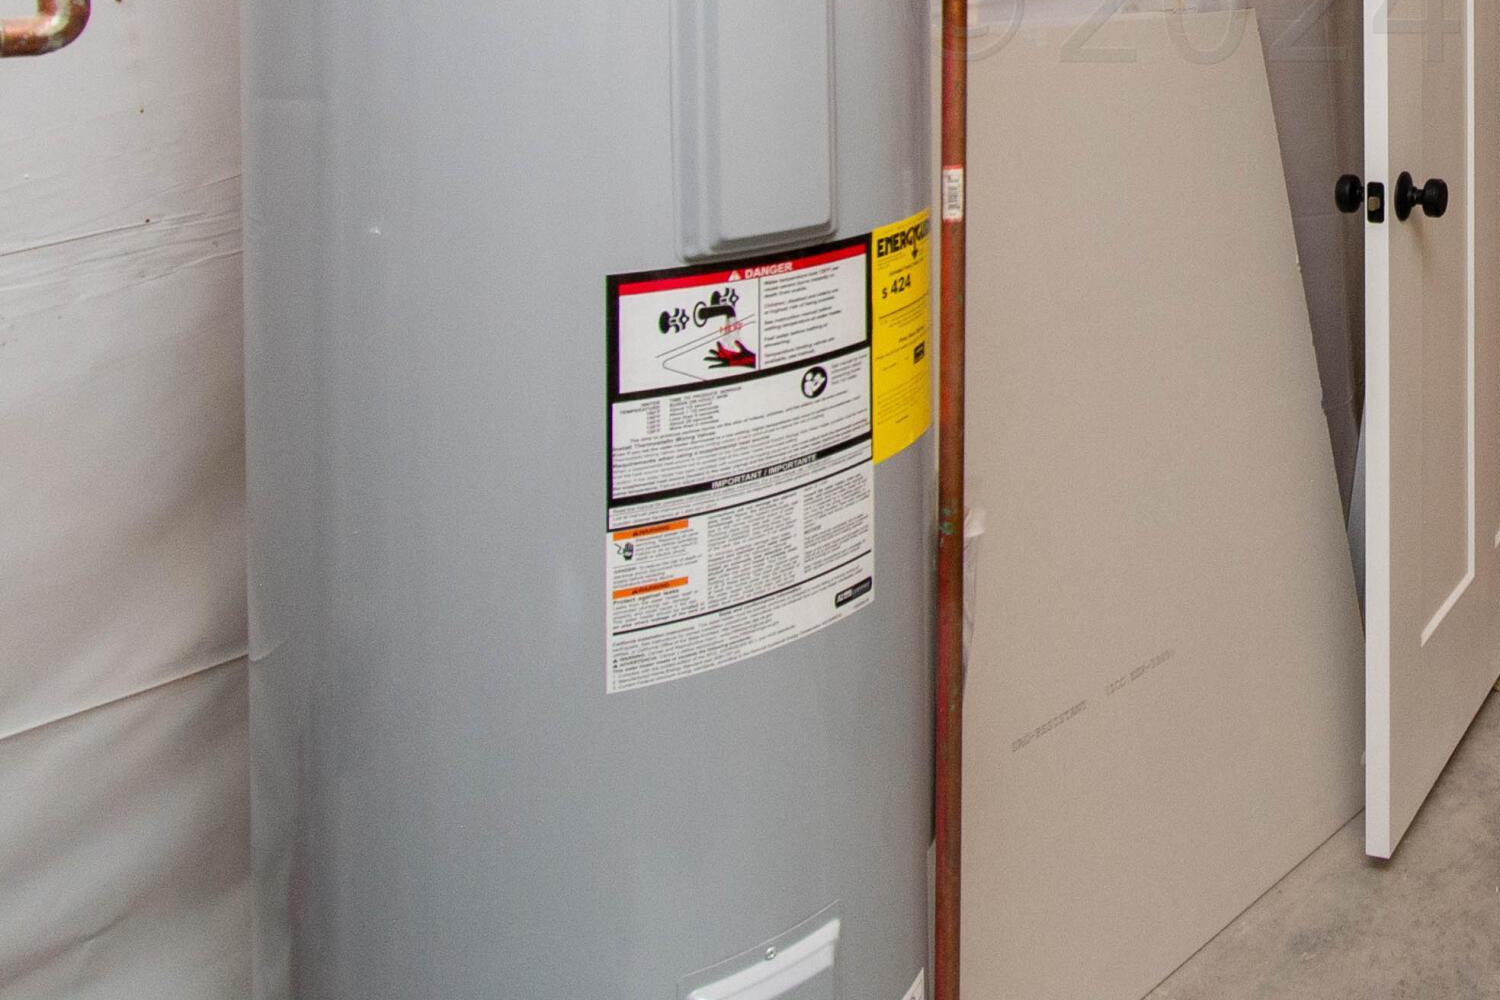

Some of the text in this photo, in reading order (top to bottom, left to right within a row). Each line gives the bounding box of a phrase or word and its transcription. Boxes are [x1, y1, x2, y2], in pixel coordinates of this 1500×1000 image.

[745, 260, 793, 280] DANGER
[891, 273, 911, 294] 424
[711, 469, 763, 489] IMPORTANT
[768, 453, 818, 476] IMPORTANTE
